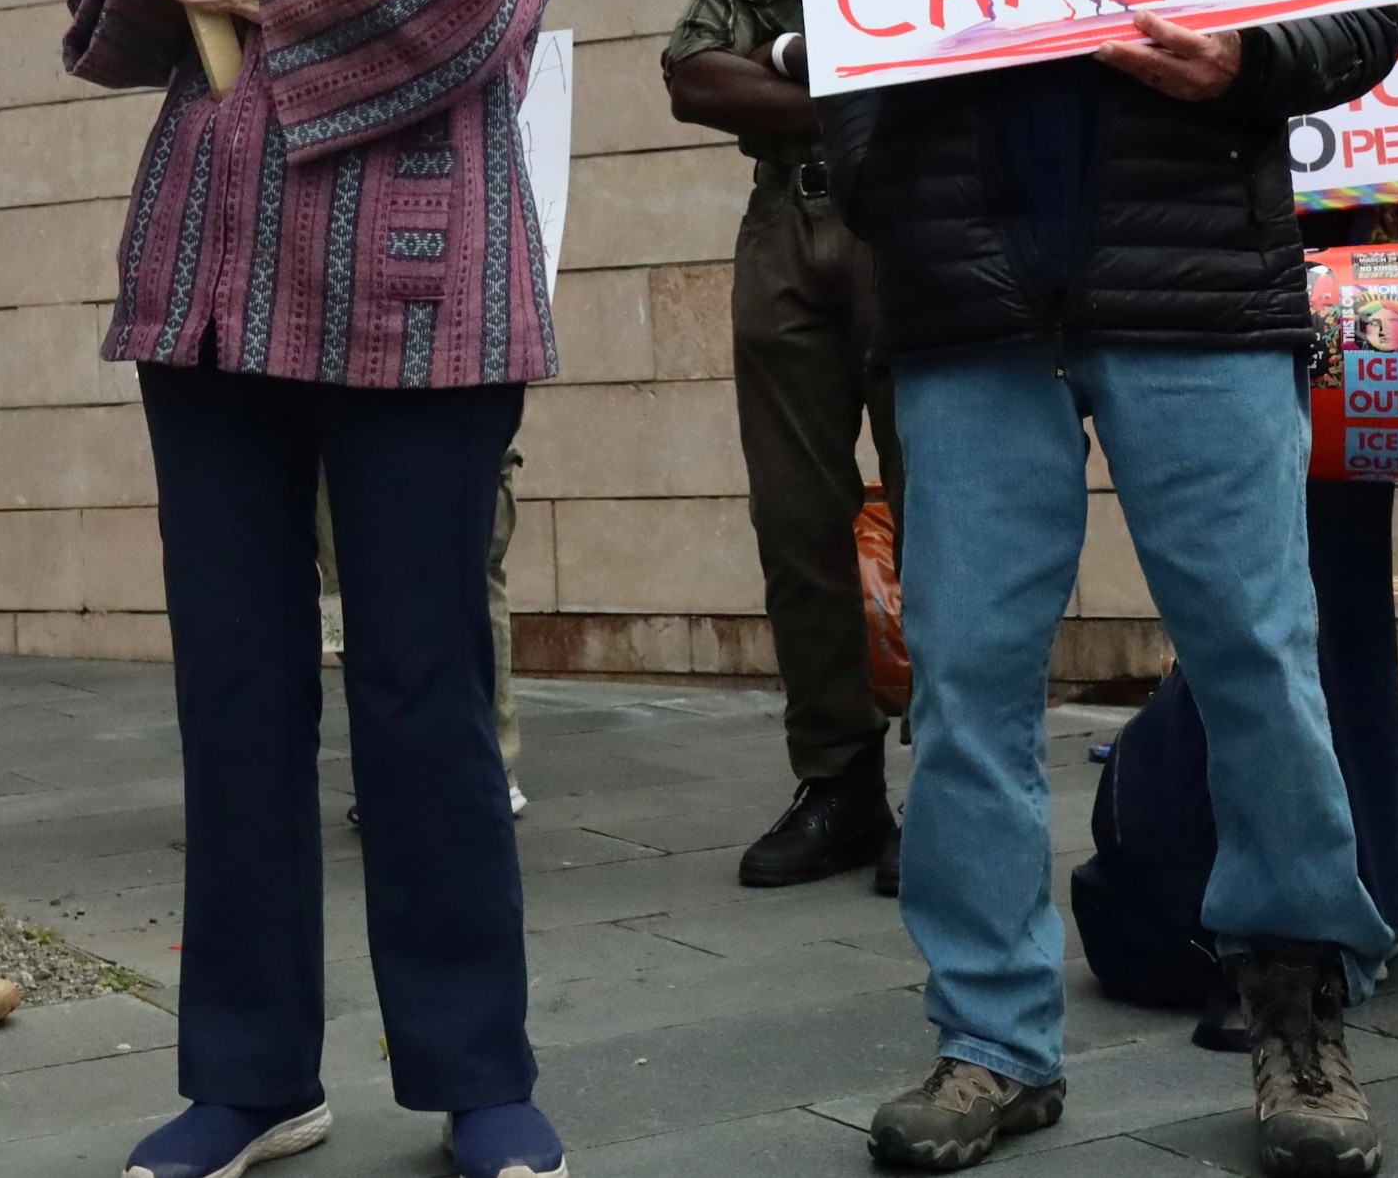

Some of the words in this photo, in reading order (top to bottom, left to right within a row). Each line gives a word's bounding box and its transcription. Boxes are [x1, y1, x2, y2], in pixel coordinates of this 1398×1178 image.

[1343, 320, 1355, 343] THIS
[1358, 358, 1398, 381] ICE
[1359, 432, 1398, 451] ICE
